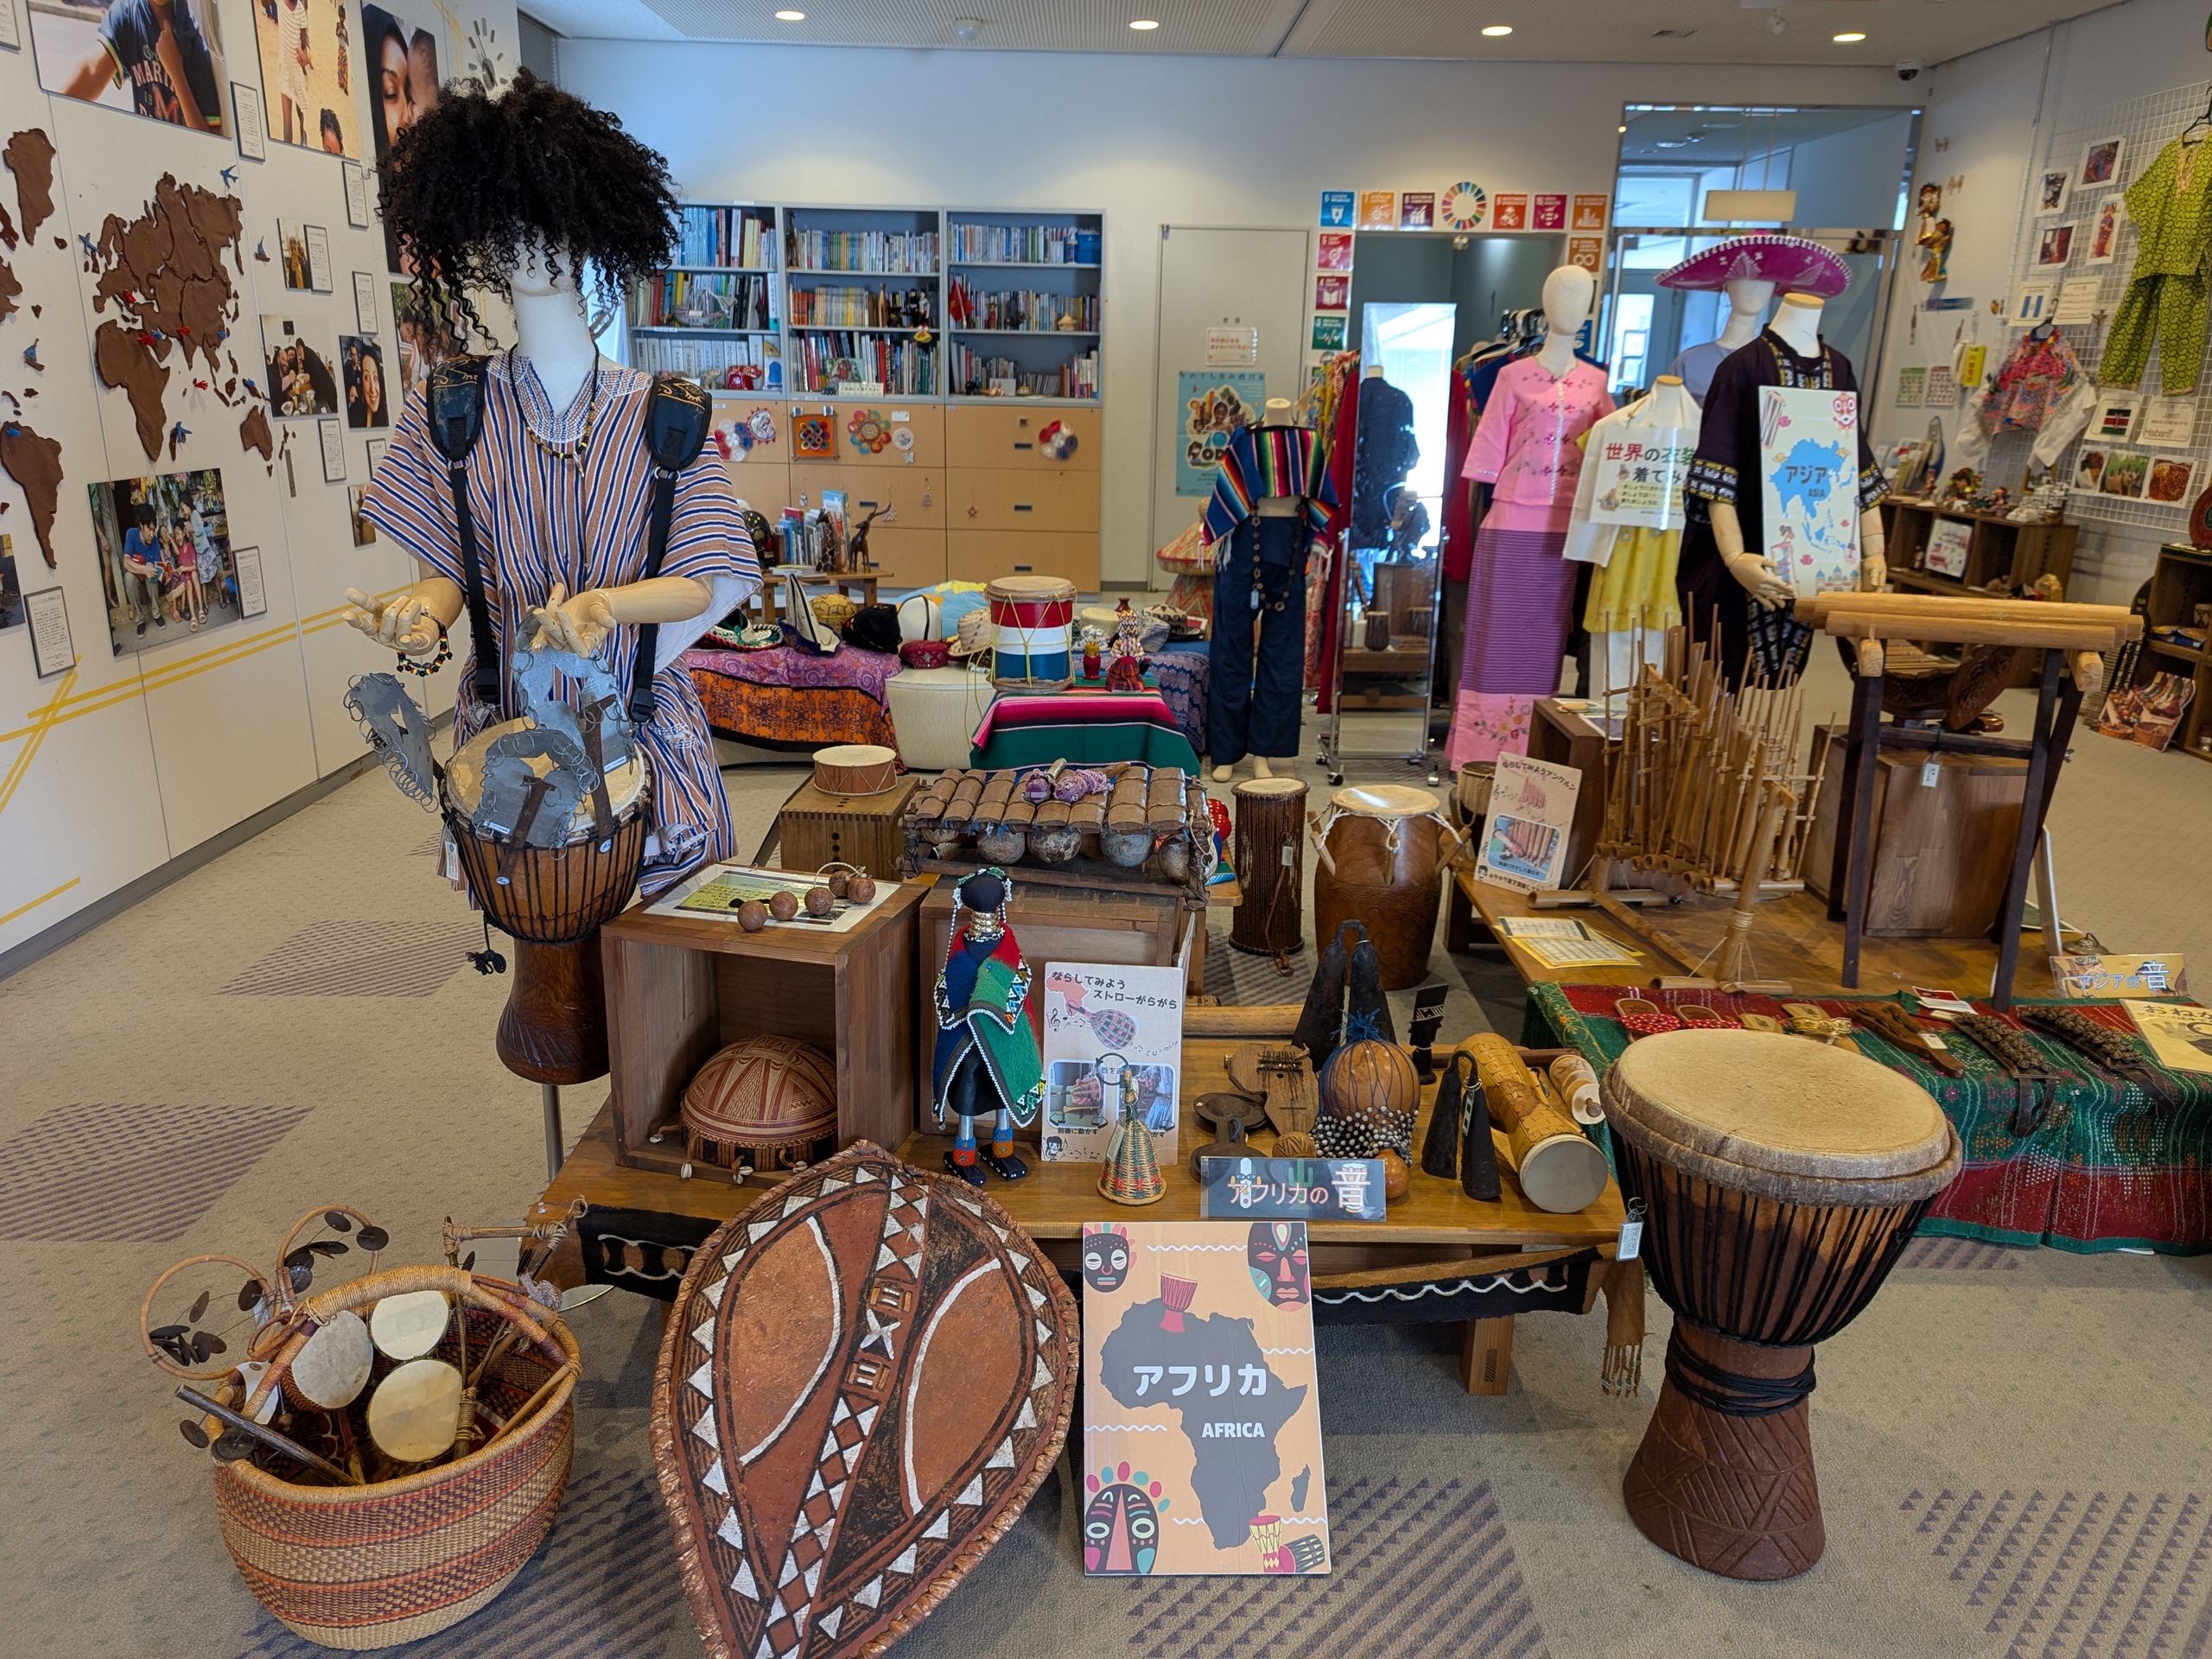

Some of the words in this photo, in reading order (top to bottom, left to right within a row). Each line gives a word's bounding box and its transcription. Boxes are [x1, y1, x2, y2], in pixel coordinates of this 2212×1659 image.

[131, 60, 175, 92] MARI
[1785, 465, 1827, 484] アジア
[1808, 488, 1826, 498] ASIA
[1052, 970, 1126, 990] ならしてみよう
[2077, 960, 2171, 990] アジアの音
[1093, 989, 1178, 1010] ストローがらがら
[1058, 1127, 1099, 1135] 前後に動かす
[1227, 1166, 1372, 1209] アフリカの音
[1133, 1363, 1267, 1397] アフリカ
[1201, 1422, 1266, 1438] AFRICA
